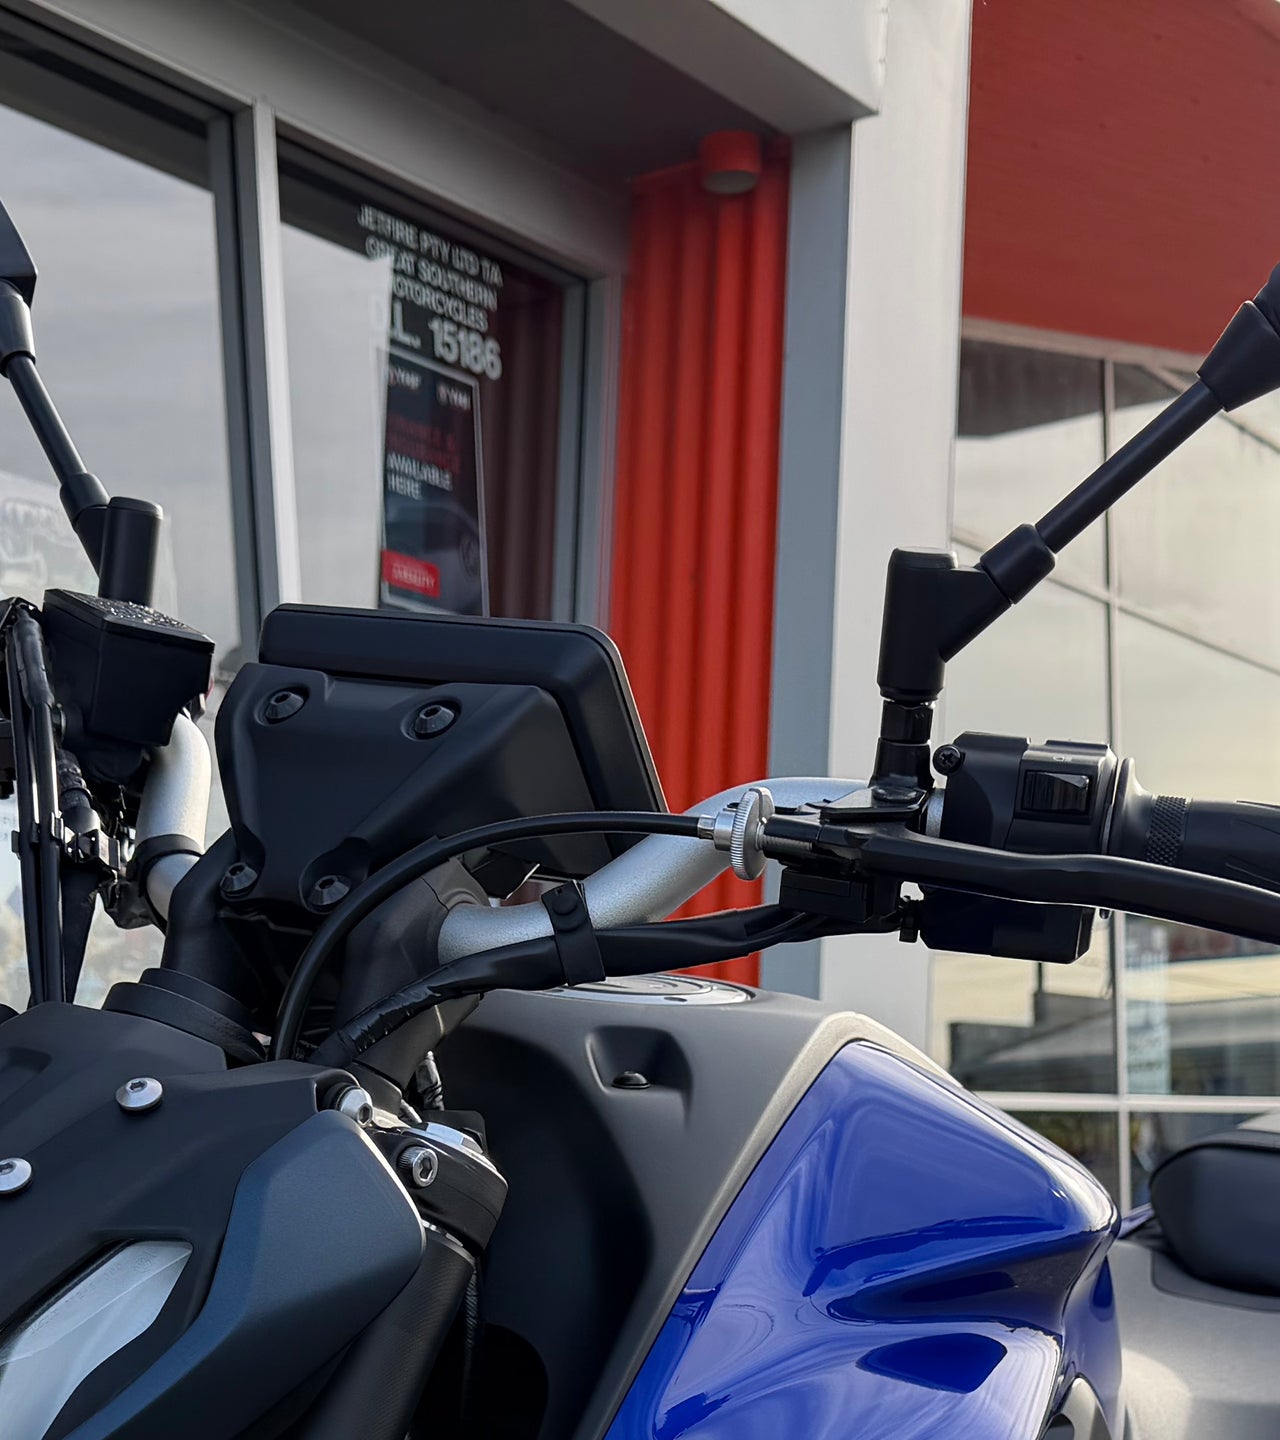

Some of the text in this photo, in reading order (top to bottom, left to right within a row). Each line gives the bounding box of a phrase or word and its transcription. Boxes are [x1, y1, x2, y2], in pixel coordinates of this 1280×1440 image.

[420, 231, 450, 262] PTY
[452, 243, 478, 275] LTD
[418, 258, 498, 311] SOUTHERN
[427, 316, 503, 381] 15186
[387, 450, 453, 491] AVAILABLE
[387, 472, 423, 501] HERE
